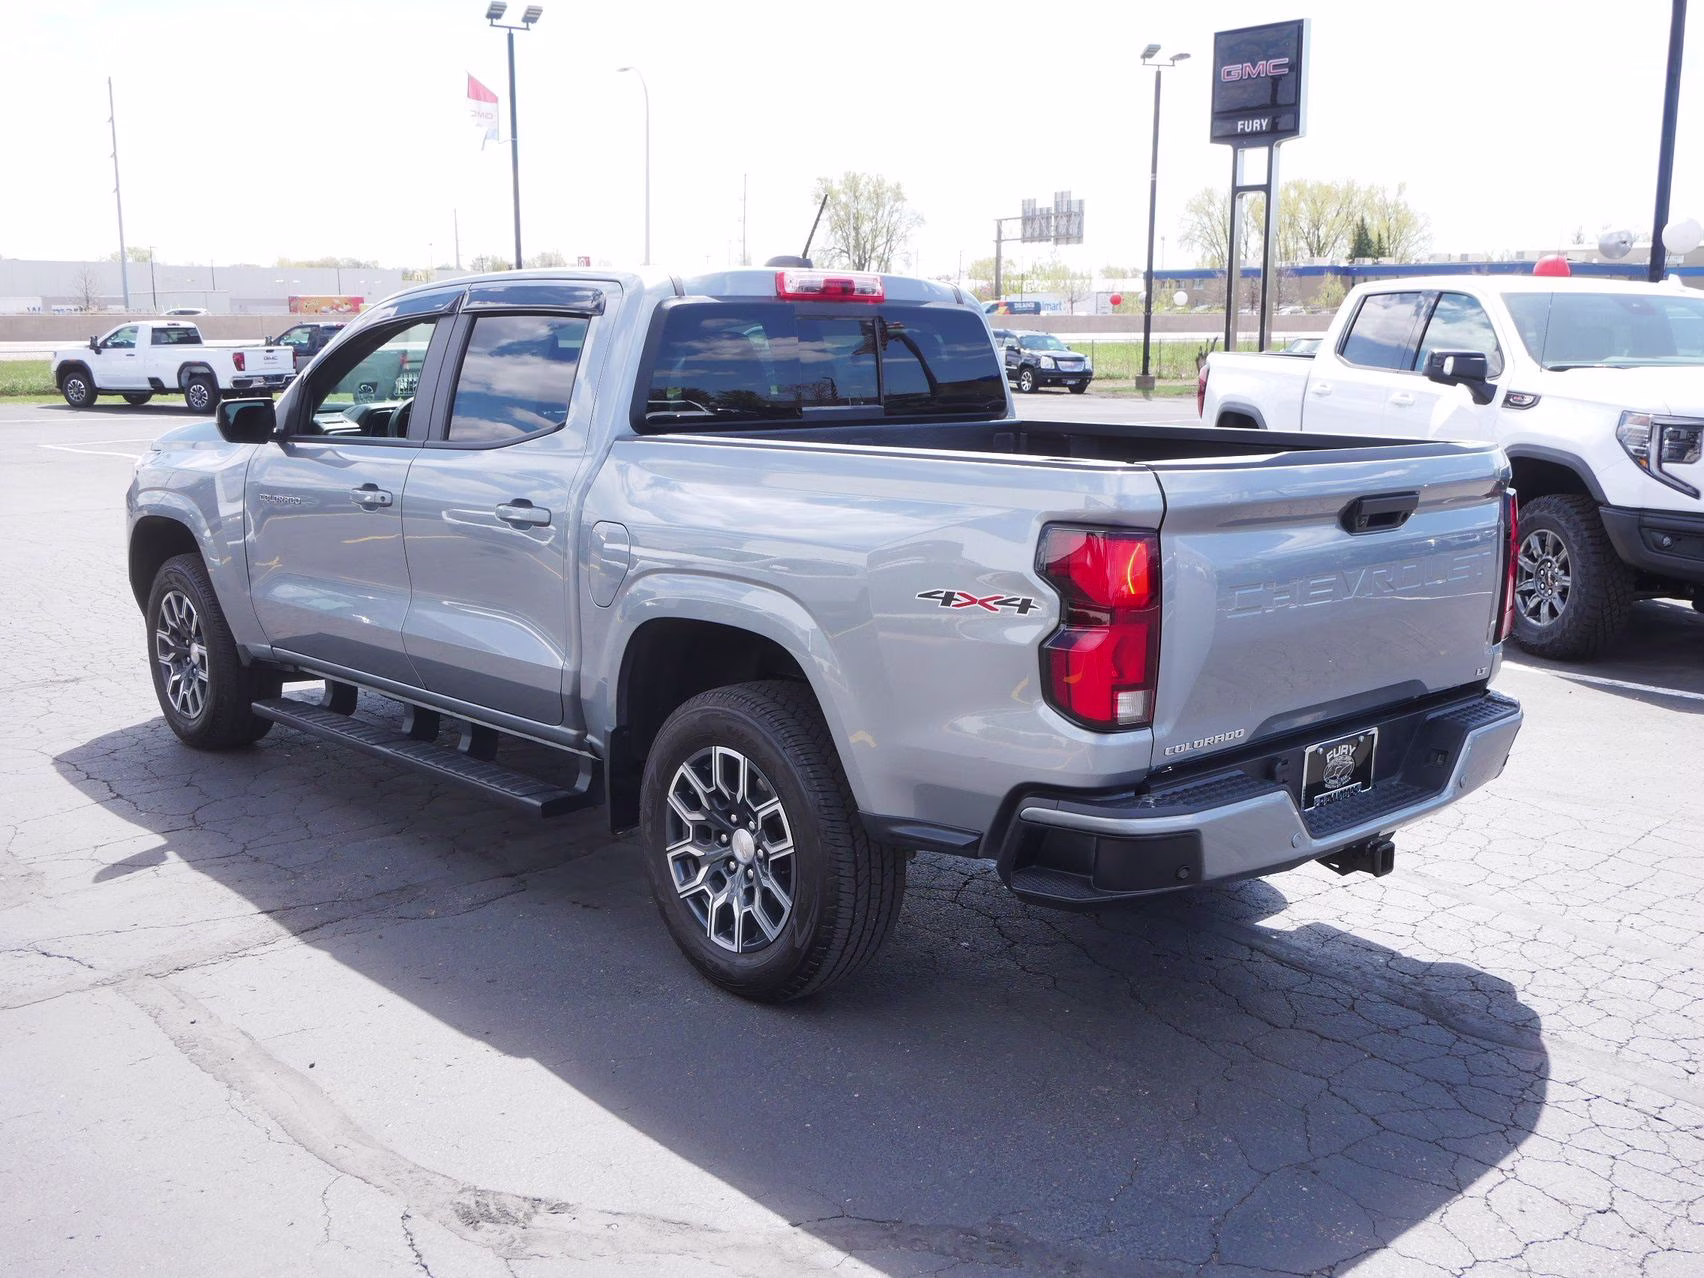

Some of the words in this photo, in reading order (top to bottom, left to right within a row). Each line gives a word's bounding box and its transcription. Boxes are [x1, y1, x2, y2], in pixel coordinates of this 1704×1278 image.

[1221, 57, 1289, 82] GMC
[1237, 118, 1269, 133] FURY
[1475, 666, 1488, 676] LT
[1164, 728, 1245, 756] COLORADO
[1326, 744, 1357, 763] FURY
